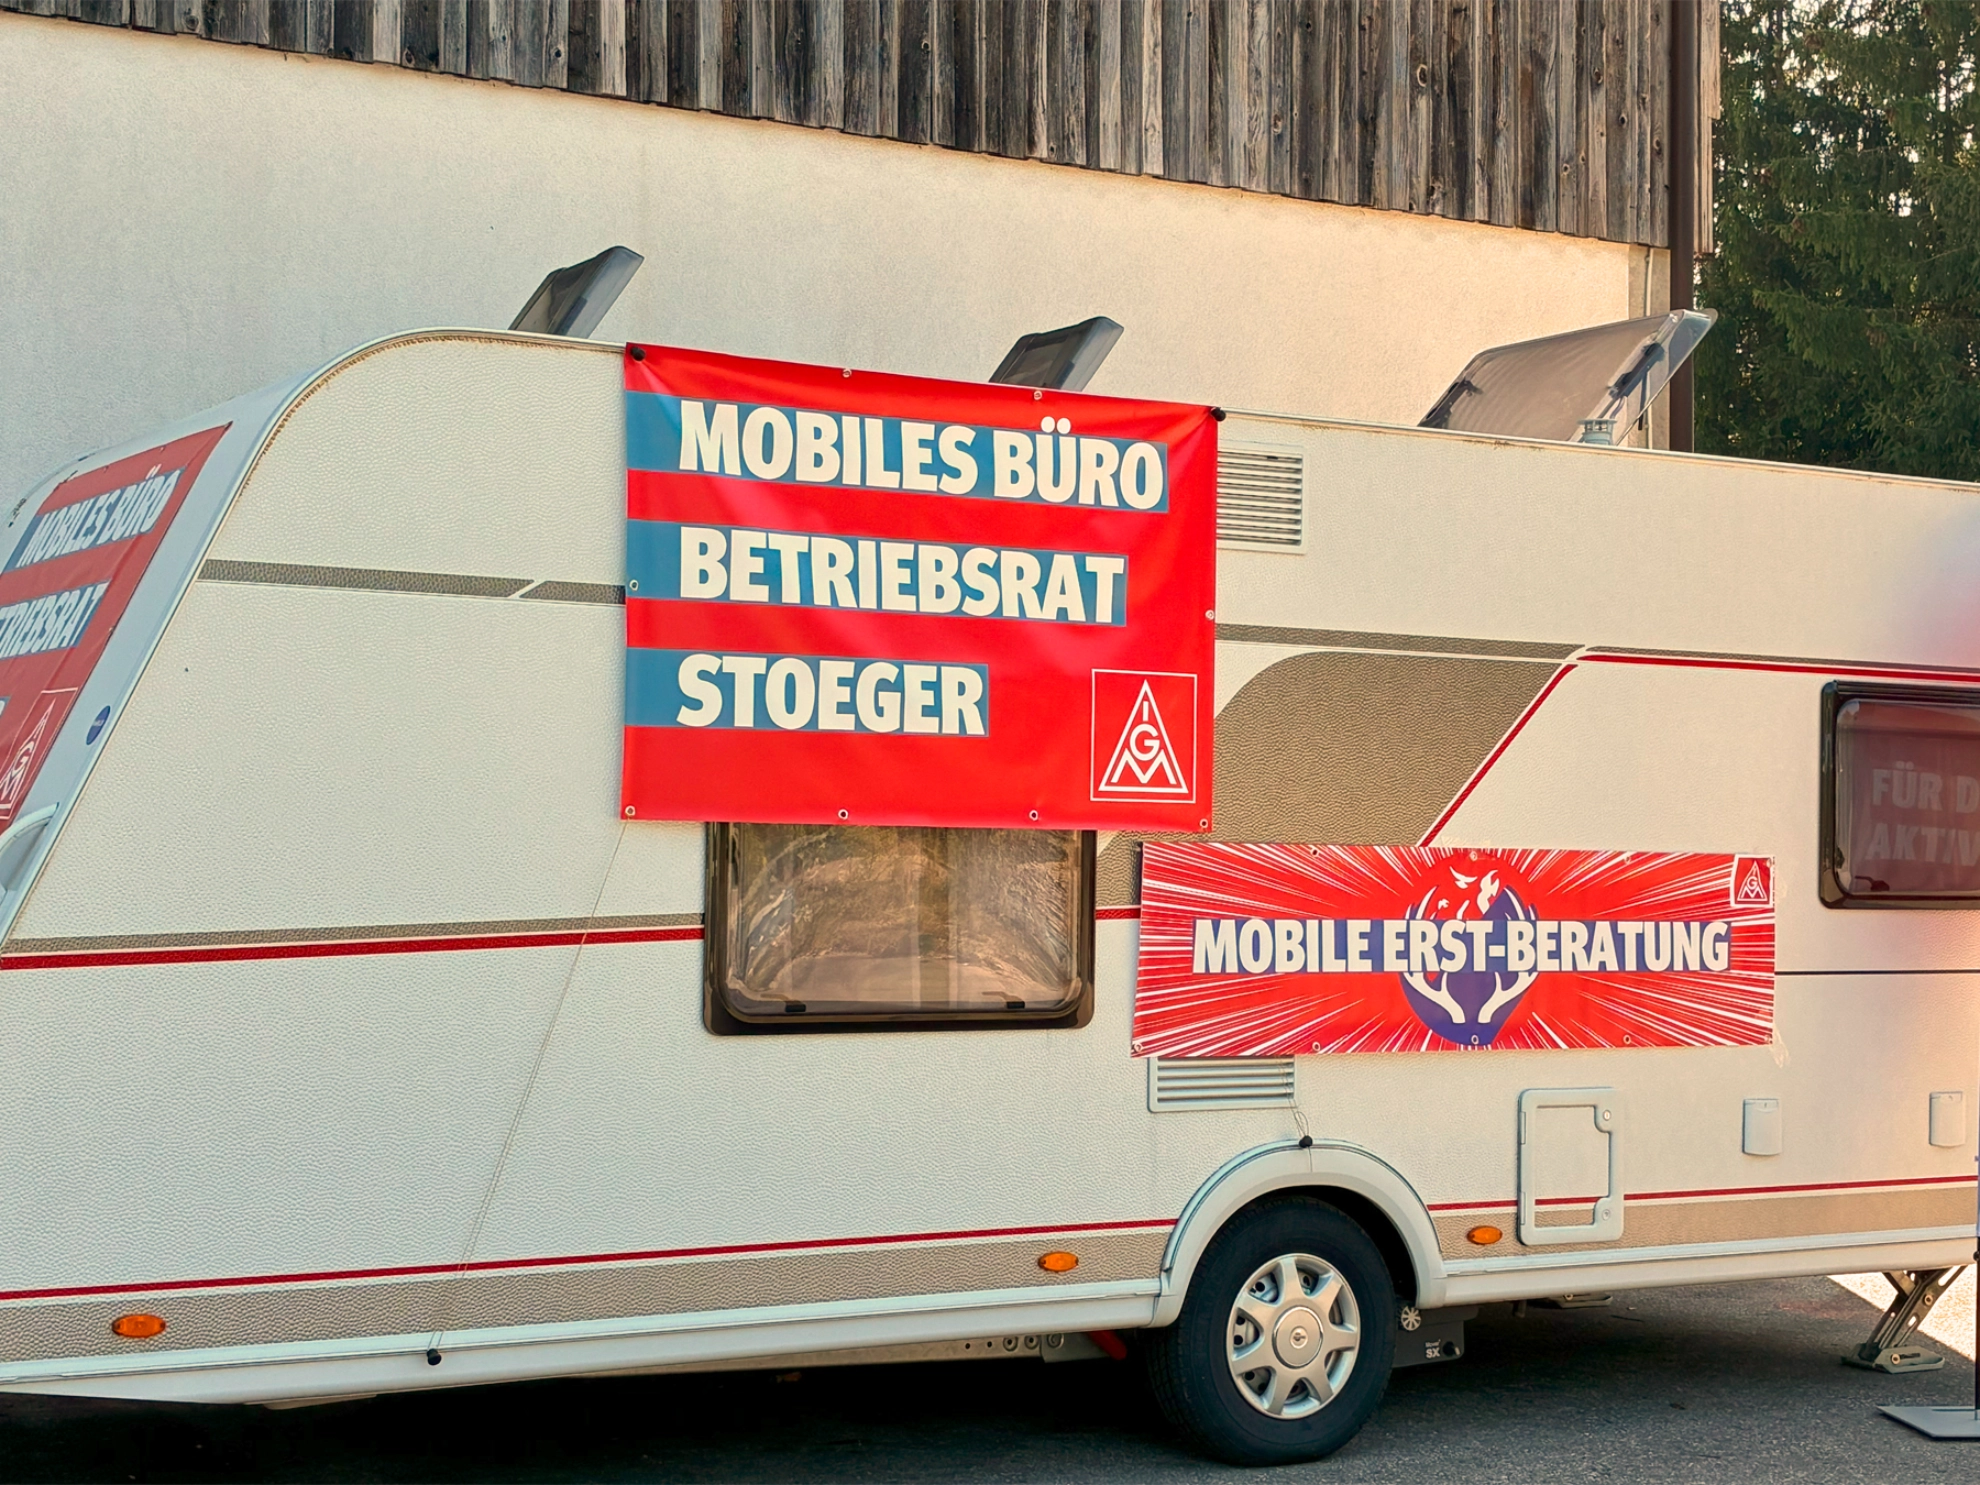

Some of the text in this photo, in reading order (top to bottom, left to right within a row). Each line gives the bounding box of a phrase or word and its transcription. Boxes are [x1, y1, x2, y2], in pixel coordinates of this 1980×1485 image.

[679, 400, 1164, 509] MOBILES BÜRO
[15, 463, 181, 568] MOBILES BÜRO
[680, 526, 1125, 624] BETRIEBSRAT
[676, 653, 986, 736] STOEGER
[1871, 761, 1943, 811] FÜR
[1865, 822, 1980, 867] AKTIV
[1193, 917, 1729, 974] MOBILE ERST-BERATUNG
[1426, 1347, 1440, 1359] SX
